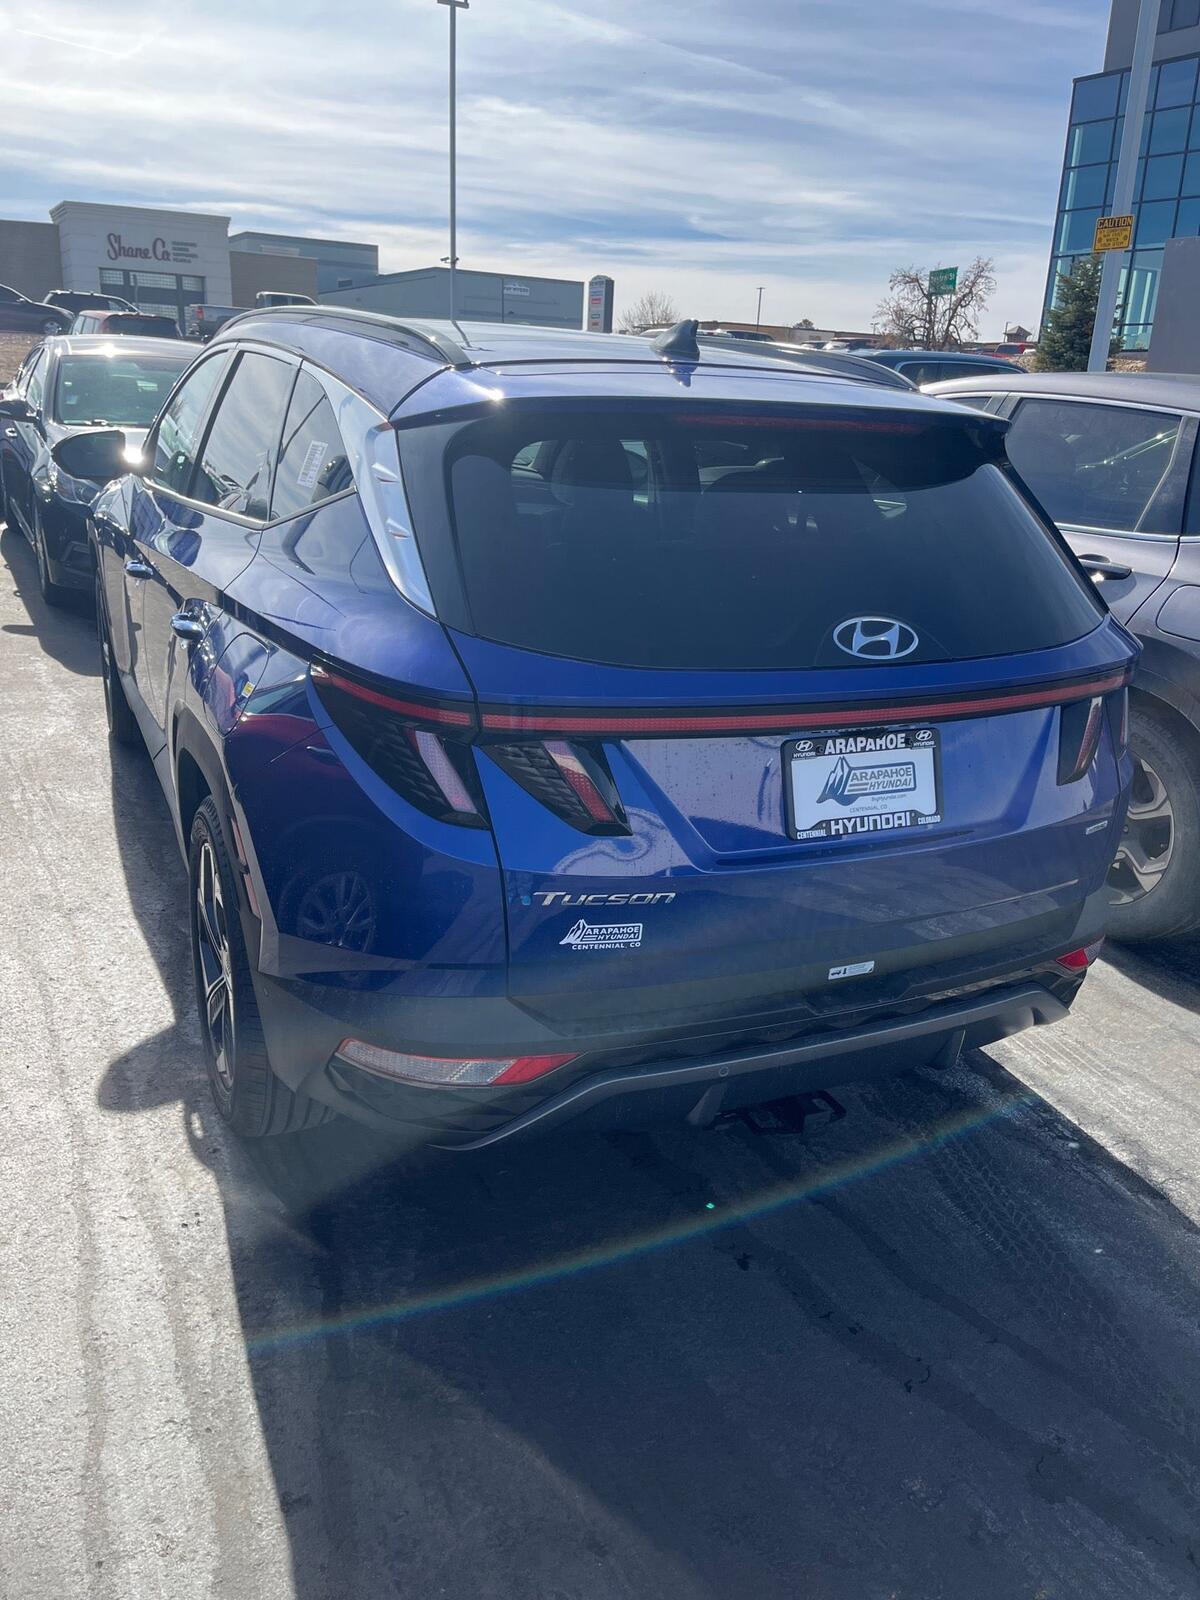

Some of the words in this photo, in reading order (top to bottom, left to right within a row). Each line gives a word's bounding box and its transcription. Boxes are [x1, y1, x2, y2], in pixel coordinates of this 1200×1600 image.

[1098, 217, 1133, 229] CAUTION
[107, 232, 152, 261] Shane
[824, 733, 906, 755] ARAPAHOE
[850, 767, 912, 782] ARAPAHOE
[868, 778, 912, 791] HYUNDAI
[797, 829, 827, 840] CENTENNIAL
[830, 811, 911, 835] HYUNDAI
[917, 815, 941, 825] COLORADO
[585, 926, 640, 935] ARAPAHOE
[597, 933, 639, 941] HYUNDAI
